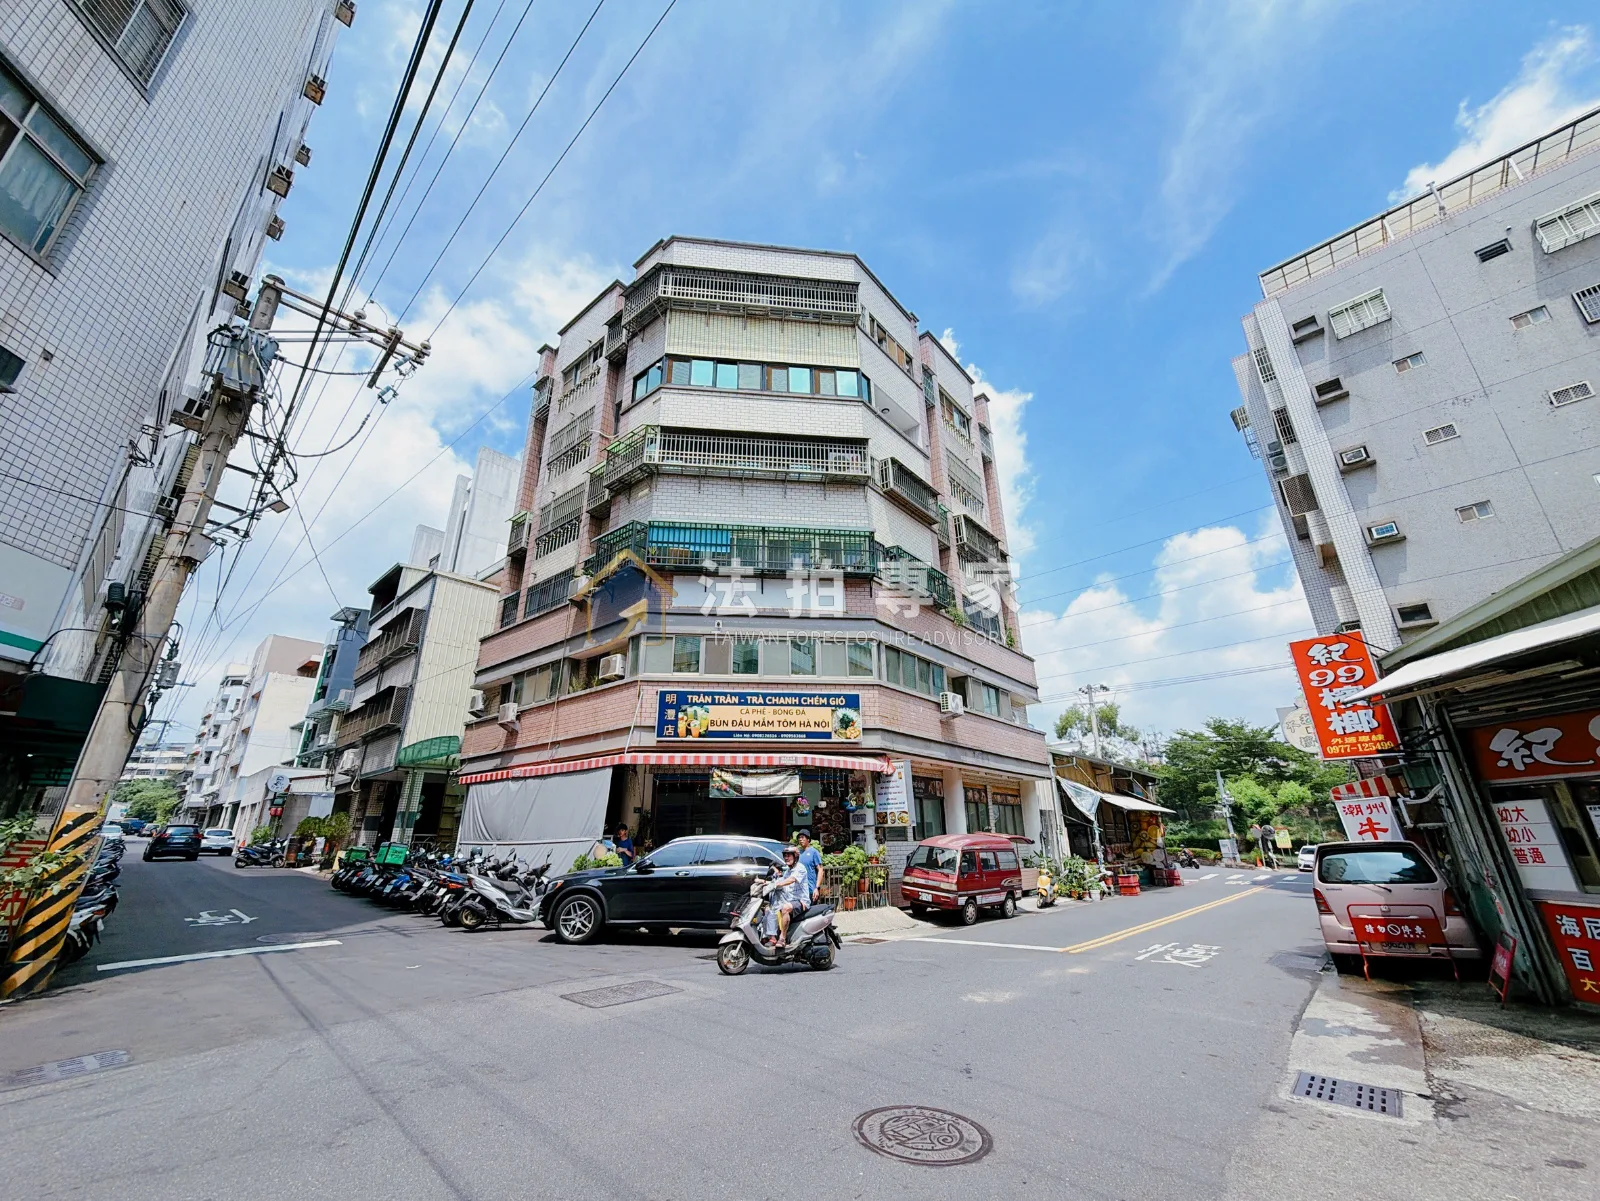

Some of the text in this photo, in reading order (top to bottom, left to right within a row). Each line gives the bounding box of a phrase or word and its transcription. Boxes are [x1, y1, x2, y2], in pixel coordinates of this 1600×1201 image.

[746, 694, 764, 705] TRÀ
[765, 696, 799, 705] CHANH
[801, 695, 828, 706] CHÉM
[829, 695, 846, 706] GIÓ
[710, 718, 729, 727] BÚN
[1326, 741, 1394, 754] 0977-125499
[1342, 802, 1388, 817] 潮州
[1497, 806, 1528, 823] 幼大
[1358, 817, 1389, 840] 牛
[1505, 826, 1537, 843] 幼小
[1512, 847, 1546, 864] 普通
[1567, 947, 1594, 972] 百
